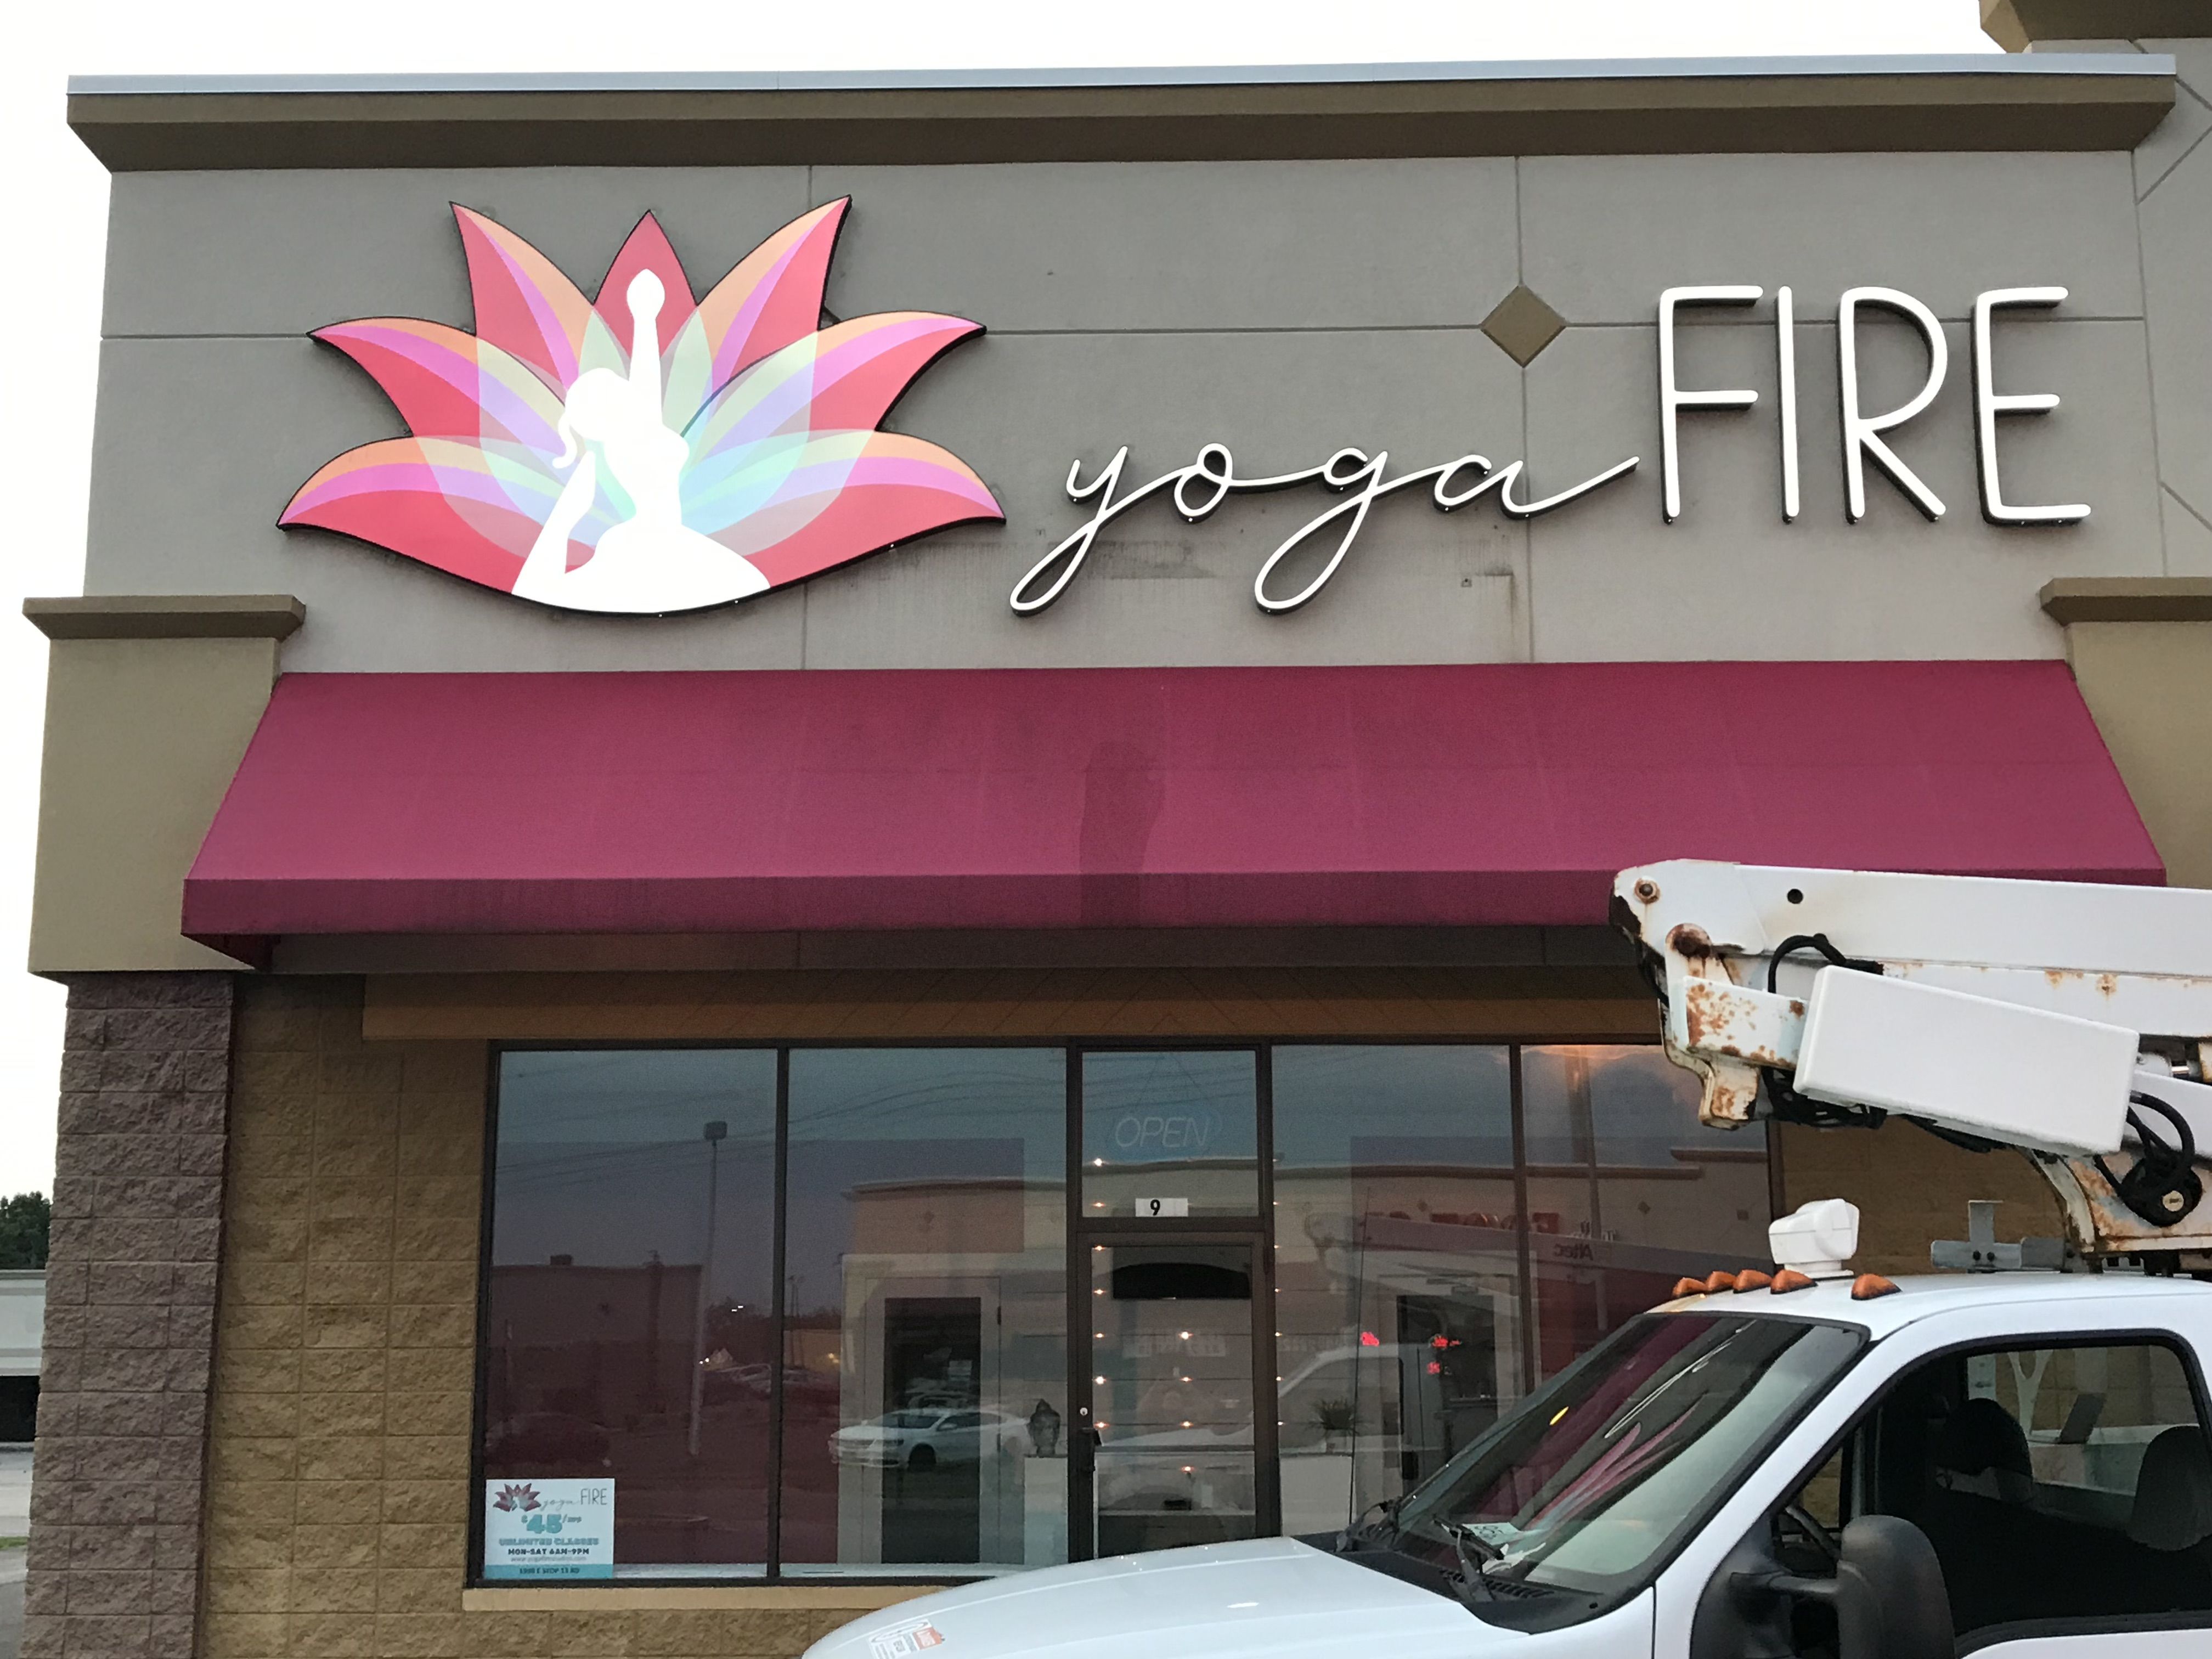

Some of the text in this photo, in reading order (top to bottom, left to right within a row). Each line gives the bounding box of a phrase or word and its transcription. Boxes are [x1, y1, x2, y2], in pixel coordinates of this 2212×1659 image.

[1009, 284, 2092, 613] yoga FIRE
[1115, 1116, 1210, 1148] OPEN
[1150, 1198, 1161, 1216] 9
[539, 1487, 608, 1513] yoga FIRE
[554, 1537, 599, 1546] CLASSES
